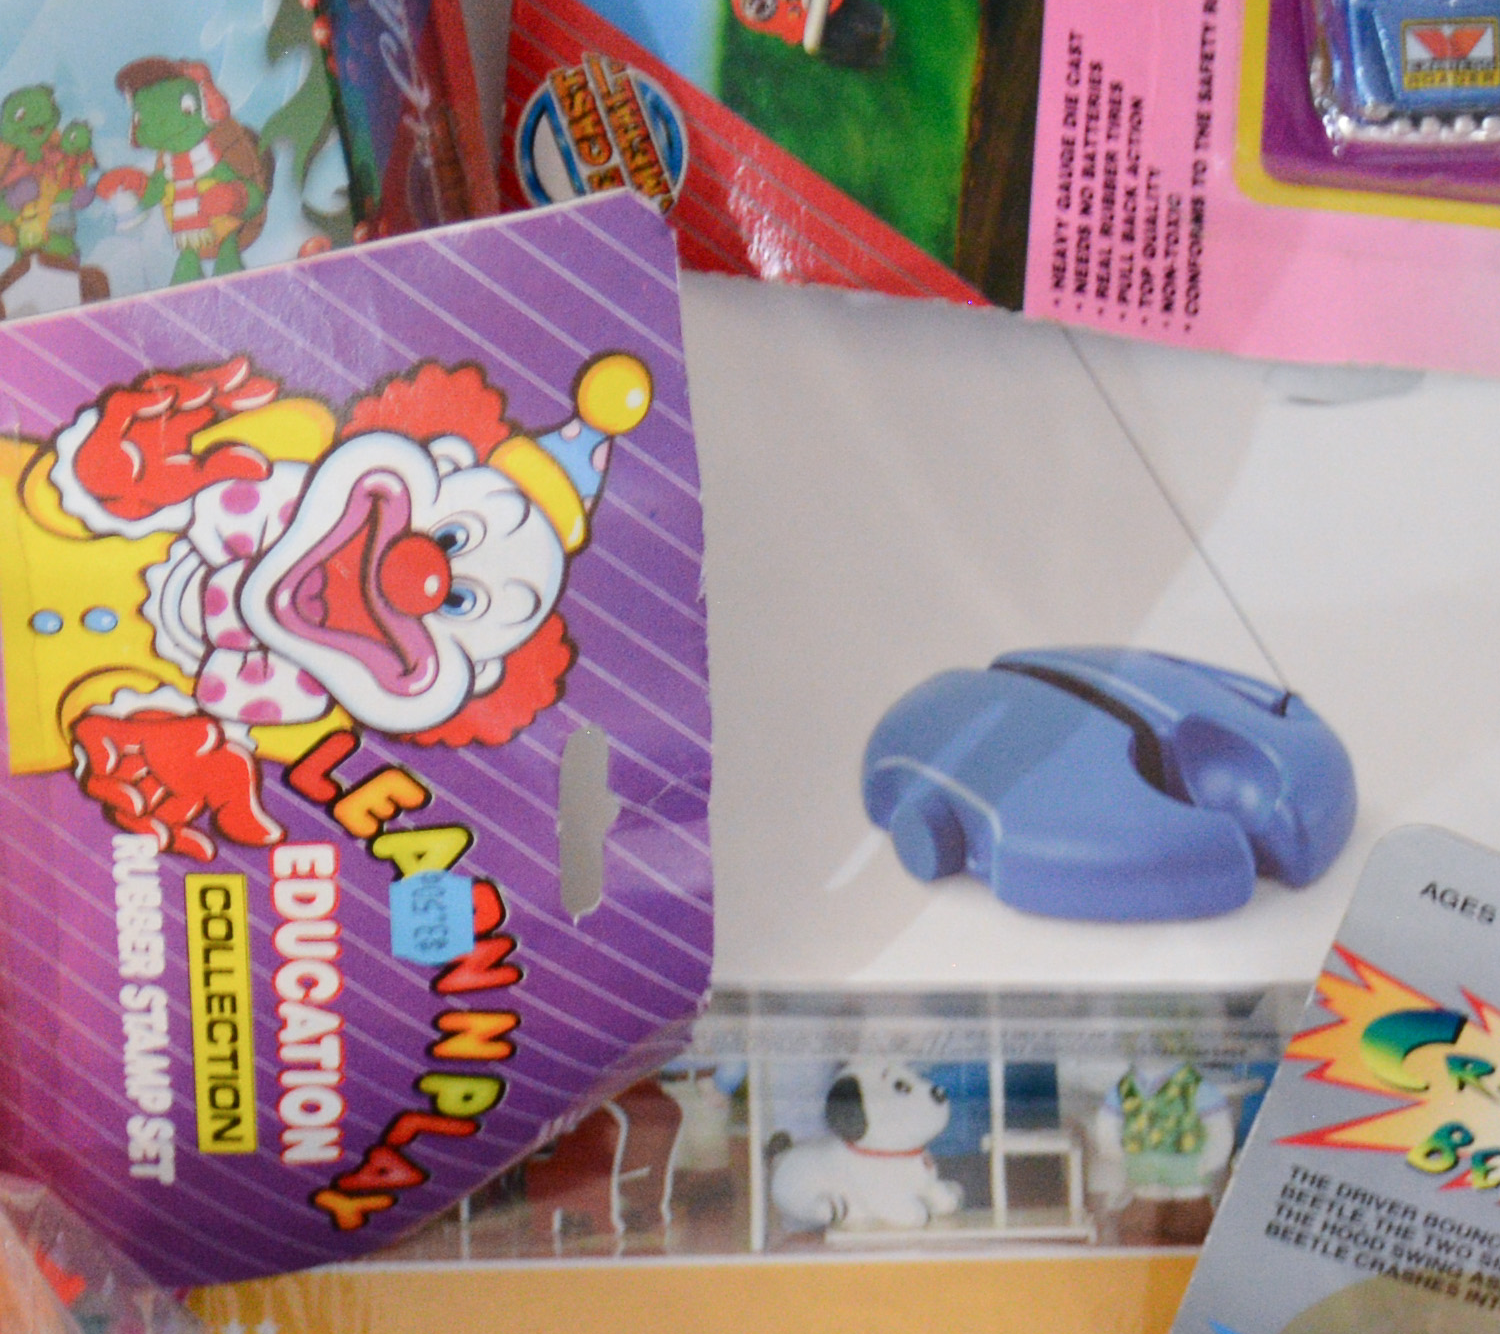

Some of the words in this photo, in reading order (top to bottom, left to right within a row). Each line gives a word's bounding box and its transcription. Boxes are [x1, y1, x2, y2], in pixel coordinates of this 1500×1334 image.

[1064, 30, 1083, 86] CAST
[1197, 22, 1218, 104] SAFETY
[1062, 94, 1079, 128] DIE
[1080, 60, 1104, 180] BATTERIES
[1105, 81, 1125, 142] TIRES
[1125, 96, 1145, 179] ACTION
[1194, 109, 1212, 150] THE
[1056, 133, 1076, 210] GAUGE
[1078, 185, 1096, 216] NO
[1099, 147, 1120, 238] RUBBER
[1192, 157, 1208, 187] TO
[1120, 186, 1139, 242] BACK
[1141, 166, 1162, 259] QUALITY
[1051, 216, 1071, 291] HEAVY
[1073, 224, 1093, 295] NEEDS
[1095, 245, 1114, 300] REAL
[1116, 252, 1135, 306] PULL
[1138, 266, 1156, 309] TOP
[1160, 192, 1183, 313] NON-TOXIC
[1182, 194, 1207, 317] CONFORMS
[111, 833, 166, 981] RUBBER
[1419, 879, 1497, 925] AGES
[197, 884, 244, 1147] COLLECTION
[270, 841, 345, 1166] EDUCATION
[431, 1011, 520, 1063] N
[118, 983, 174, 1119] STAMP
[126, 1114, 177, 1187] SET
[310, 1071, 507, 1231] PLAY
[1287, 1162, 1332, 1192] THE
[1334, 1178, 1420, 1224] DRIVER
[1263, 1216, 1351, 1265] BEETLE
[1351, 1246, 1461, 1305] CRASHES
[1272, 1200, 1317, 1230] THE
[1319, 1214, 1389, 1255] HOOD
[1388, 1238, 1467, 1283] SWING
[1373, 1214, 1418, 1244] THE
[1421, 1229, 1474, 1263] TWO
